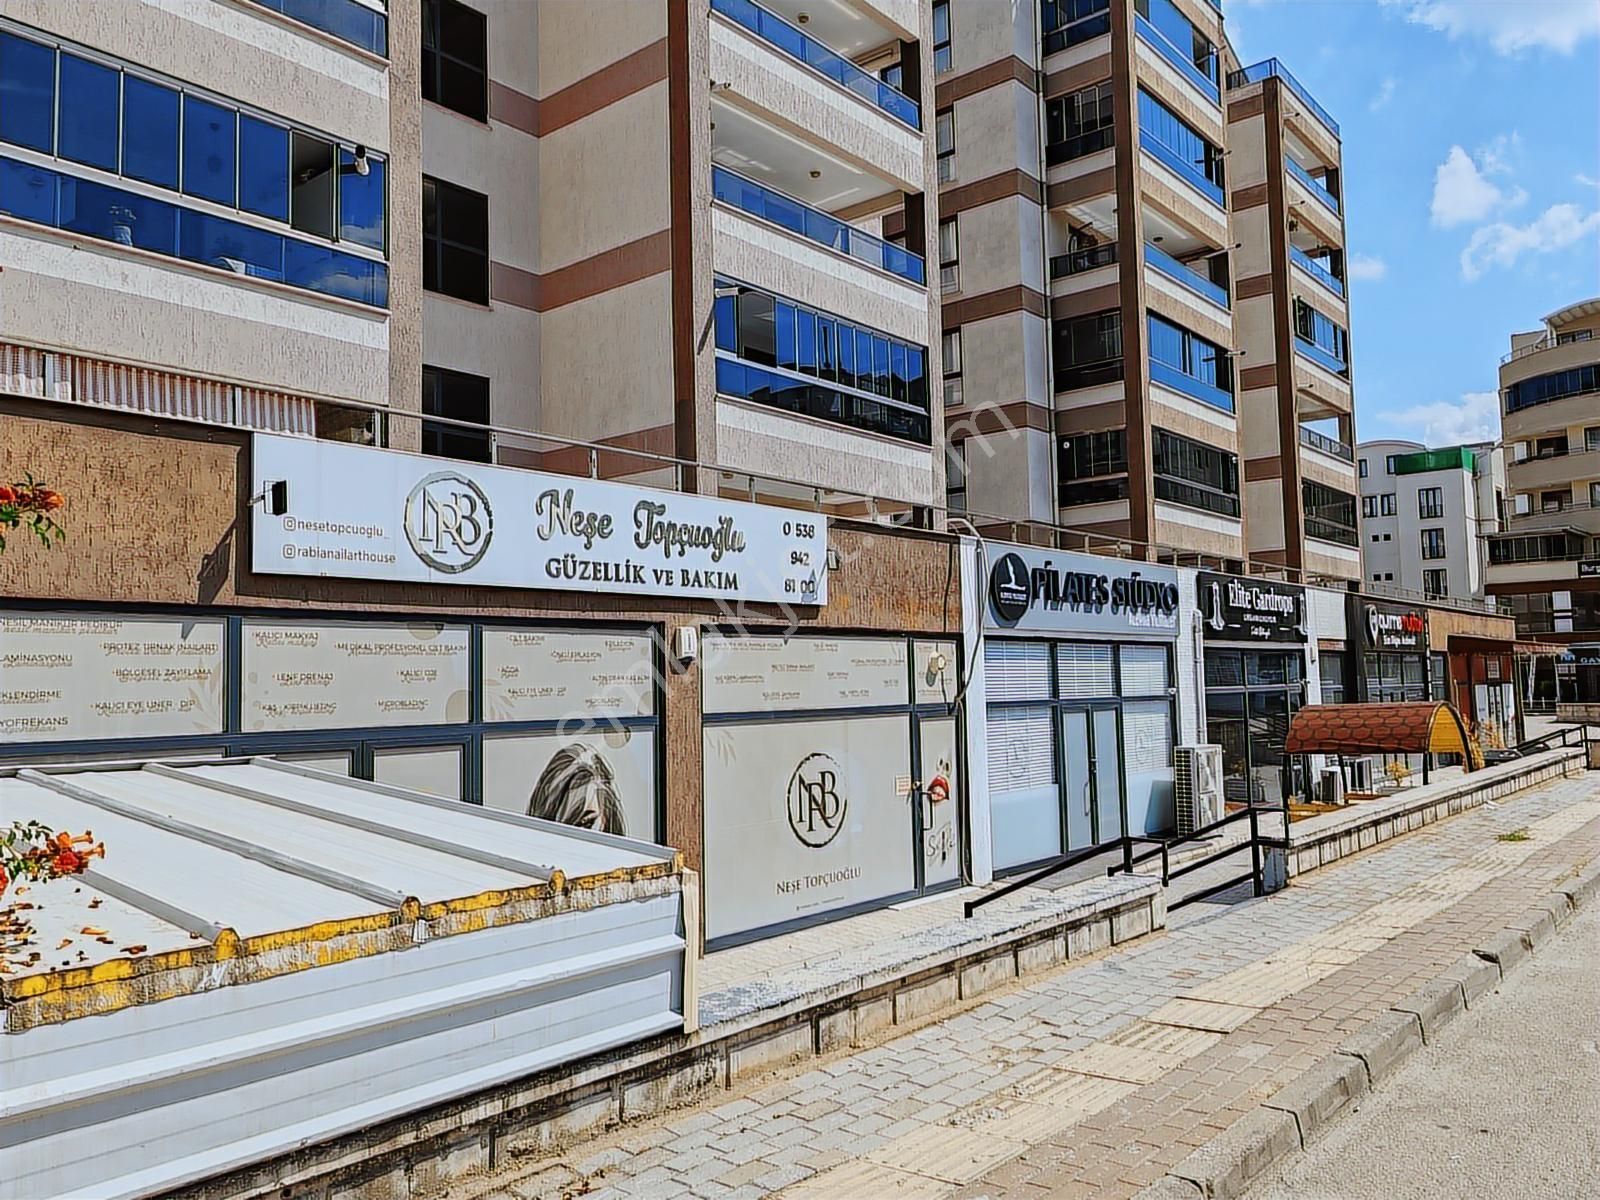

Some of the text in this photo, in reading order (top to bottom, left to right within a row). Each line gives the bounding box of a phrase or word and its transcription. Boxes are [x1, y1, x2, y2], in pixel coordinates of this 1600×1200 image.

[535, 488, 746, 563] Neşe Topçuoğlu
[782, 521, 815, 539] 0 538
[545, 553, 739, 590] GÜZELLİK VE BAKIM
[790, 551, 809, 566] 942
